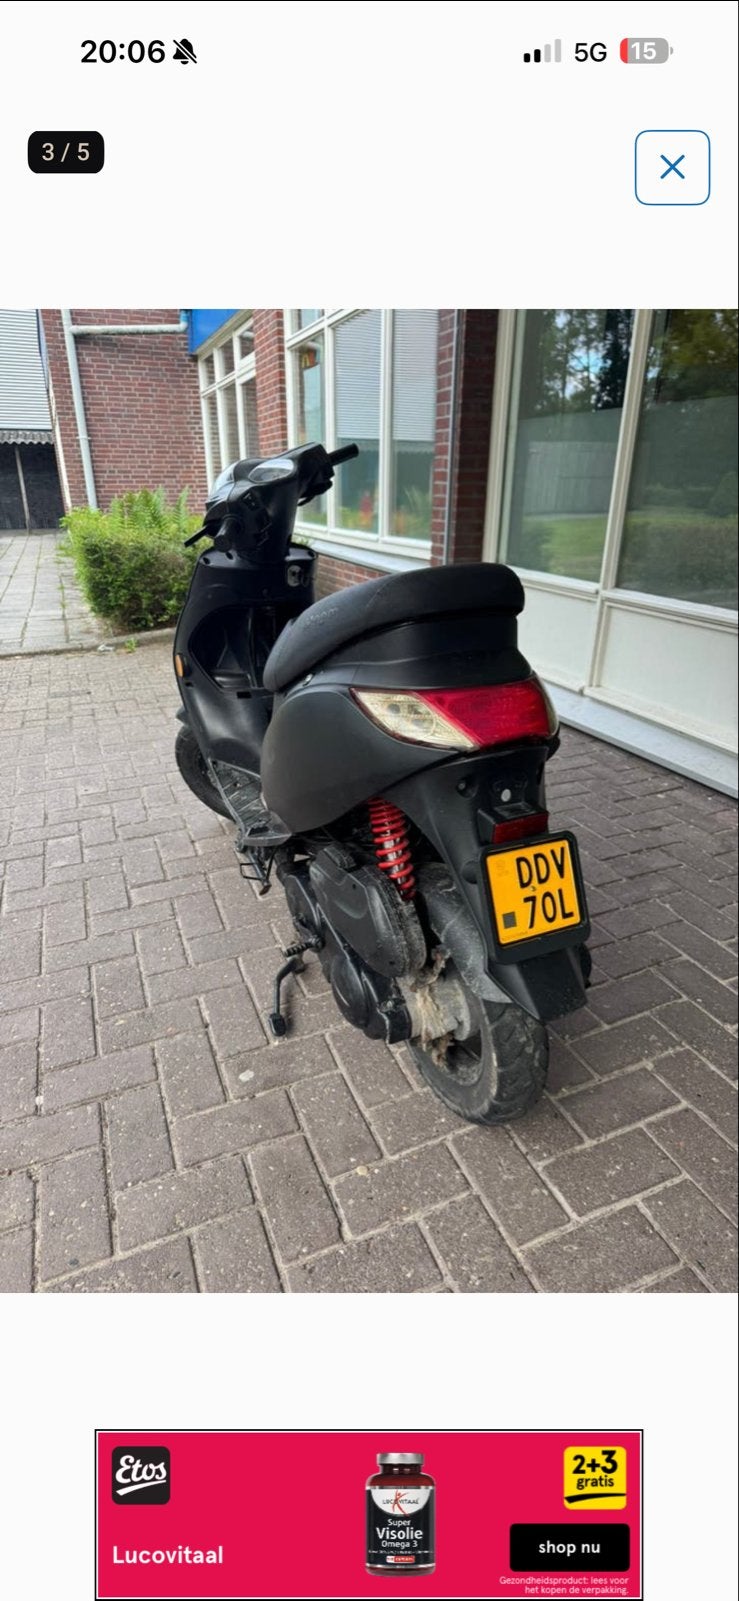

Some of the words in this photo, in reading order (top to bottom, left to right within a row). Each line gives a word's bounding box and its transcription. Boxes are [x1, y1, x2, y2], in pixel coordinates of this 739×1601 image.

[80, 40, 166, 63] 20:06
[574, 43, 607, 62] 5G
[631, 42, 657, 60] 15
[41, 143, 55, 161] 3
[78, 143, 90, 161] 5
[515, 847, 565, 889] DDV
[523, 888, 574, 929] 70L
[115, 1455, 167, 1484] Etos
[572, 1450, 618, 1475] 2+3
[576, 1475, 615, 1491] gratis
[387, 1519, 411, 1529] Super
[376, 1527, 423, 1540] Visolie
[381, 1540, 410, 1550] Omega
[412, 1540, 418, 1548] 3
[538, 1540, 576, 1557] shop
[581, 1543, 601, 1554] nu
[112, 1545, 223, 1564] Lucovitaal
[499, 1576, 589, 1587] Gezondheidsproduct:
[591, 1576, 608, 1585] lees
[525, 1586, 539, 1594] het
[541, 1586, 567, 1595] kopen
[569, 1586, 580, 1594] de
[582, 1586, 629, 1596] verpakking.
